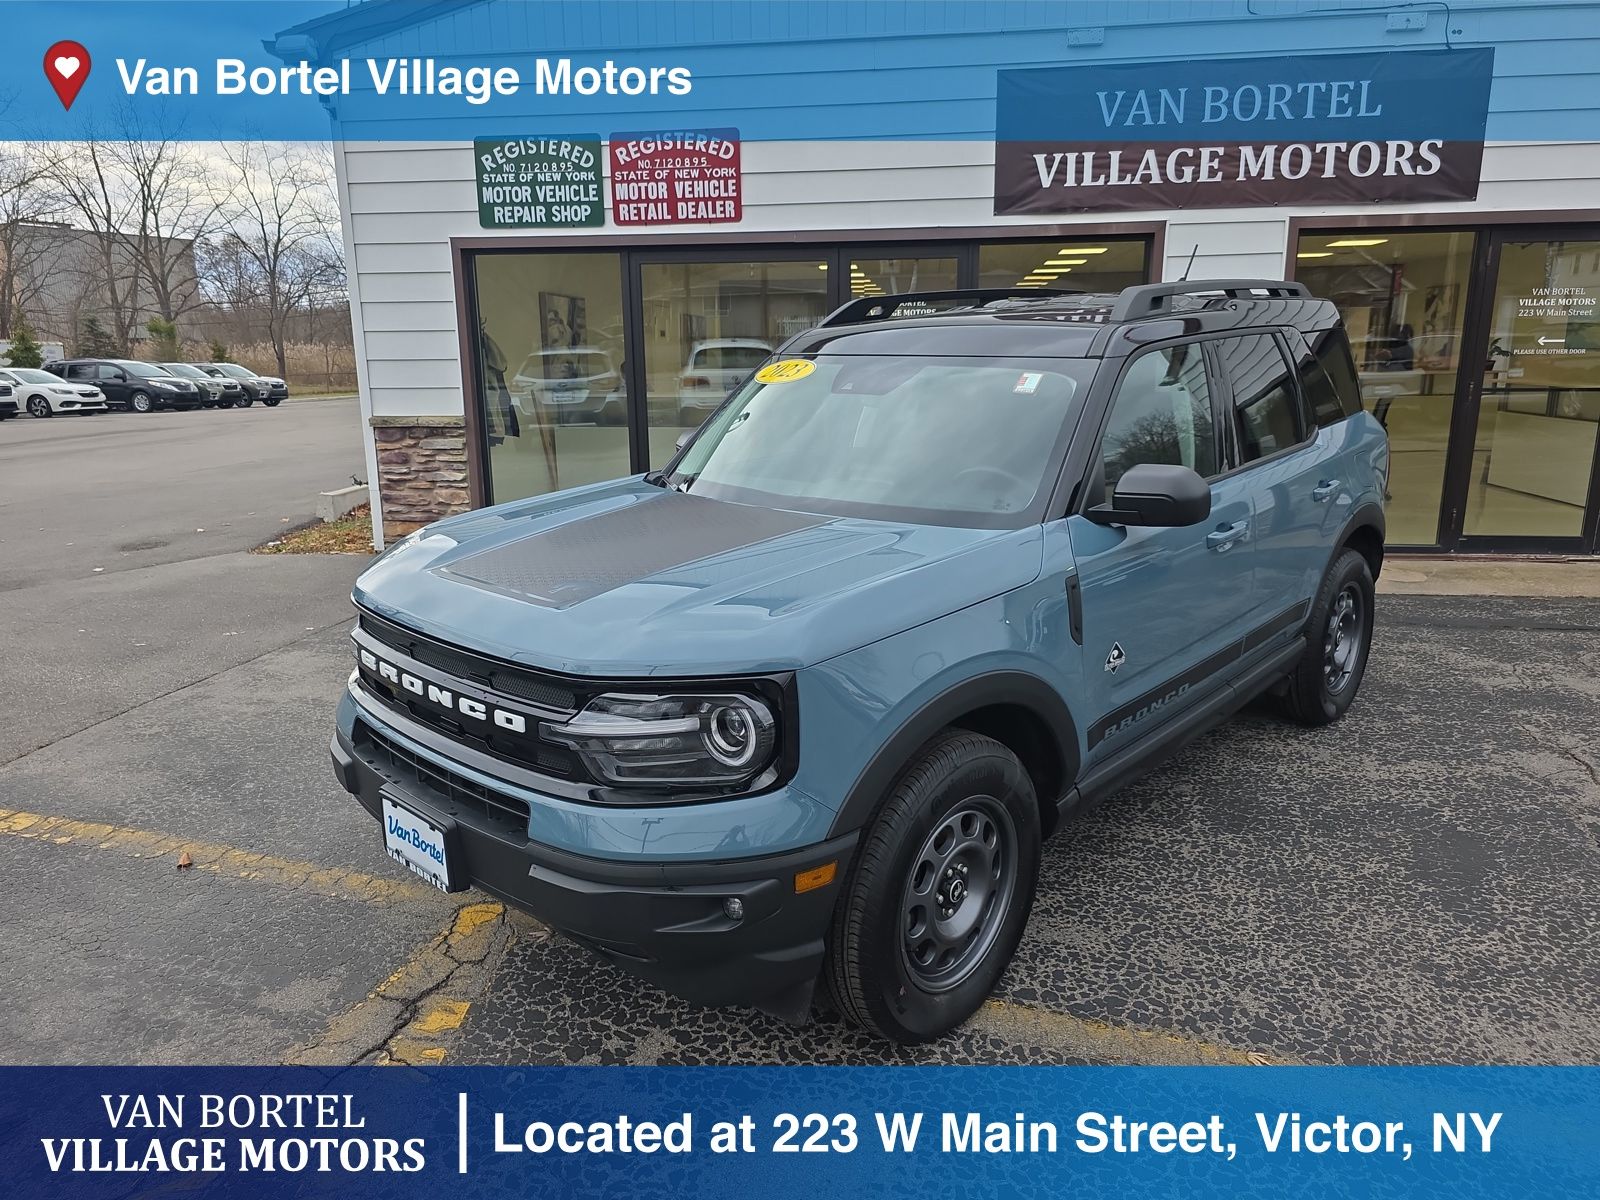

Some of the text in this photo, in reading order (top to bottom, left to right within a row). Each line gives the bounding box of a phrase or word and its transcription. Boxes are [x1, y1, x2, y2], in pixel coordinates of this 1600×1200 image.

[1096, 80, 1382, 128] VAN BORTEL
[481, 136, 595, 172] REGISTERED
[615, 132, 735, 165] REGISTERED
[503, 162, 574, 173] NO. 7120895
[637, 157, 708, 169] NO. 7120895
[1033, 139, 1443, 189] VILLAGE MOTORS
[482, 172, 596, 183] STATE OF NEW YORK
[614, 168, 737, 181] STATE OF NEW YORK
[482, 184, 599, 203] MOTOR VEHICLE
[615, 179, 737, 200] MOTOR VEHICLE
[494, 205, 591, 223] REPAIR SHOP
[619, 200, 735, 221] RETAIL DEALER
[1532, 287, 1586, 296] VAN BORTEL
[1519, 297, 1597, 306] VILLAGE MOTORS
[1518, 308, 1593, 317] 223 W Main Street
[361, 650, 526, 734] BRONCO
[1103, 684, 1190, 739] BRONCO
